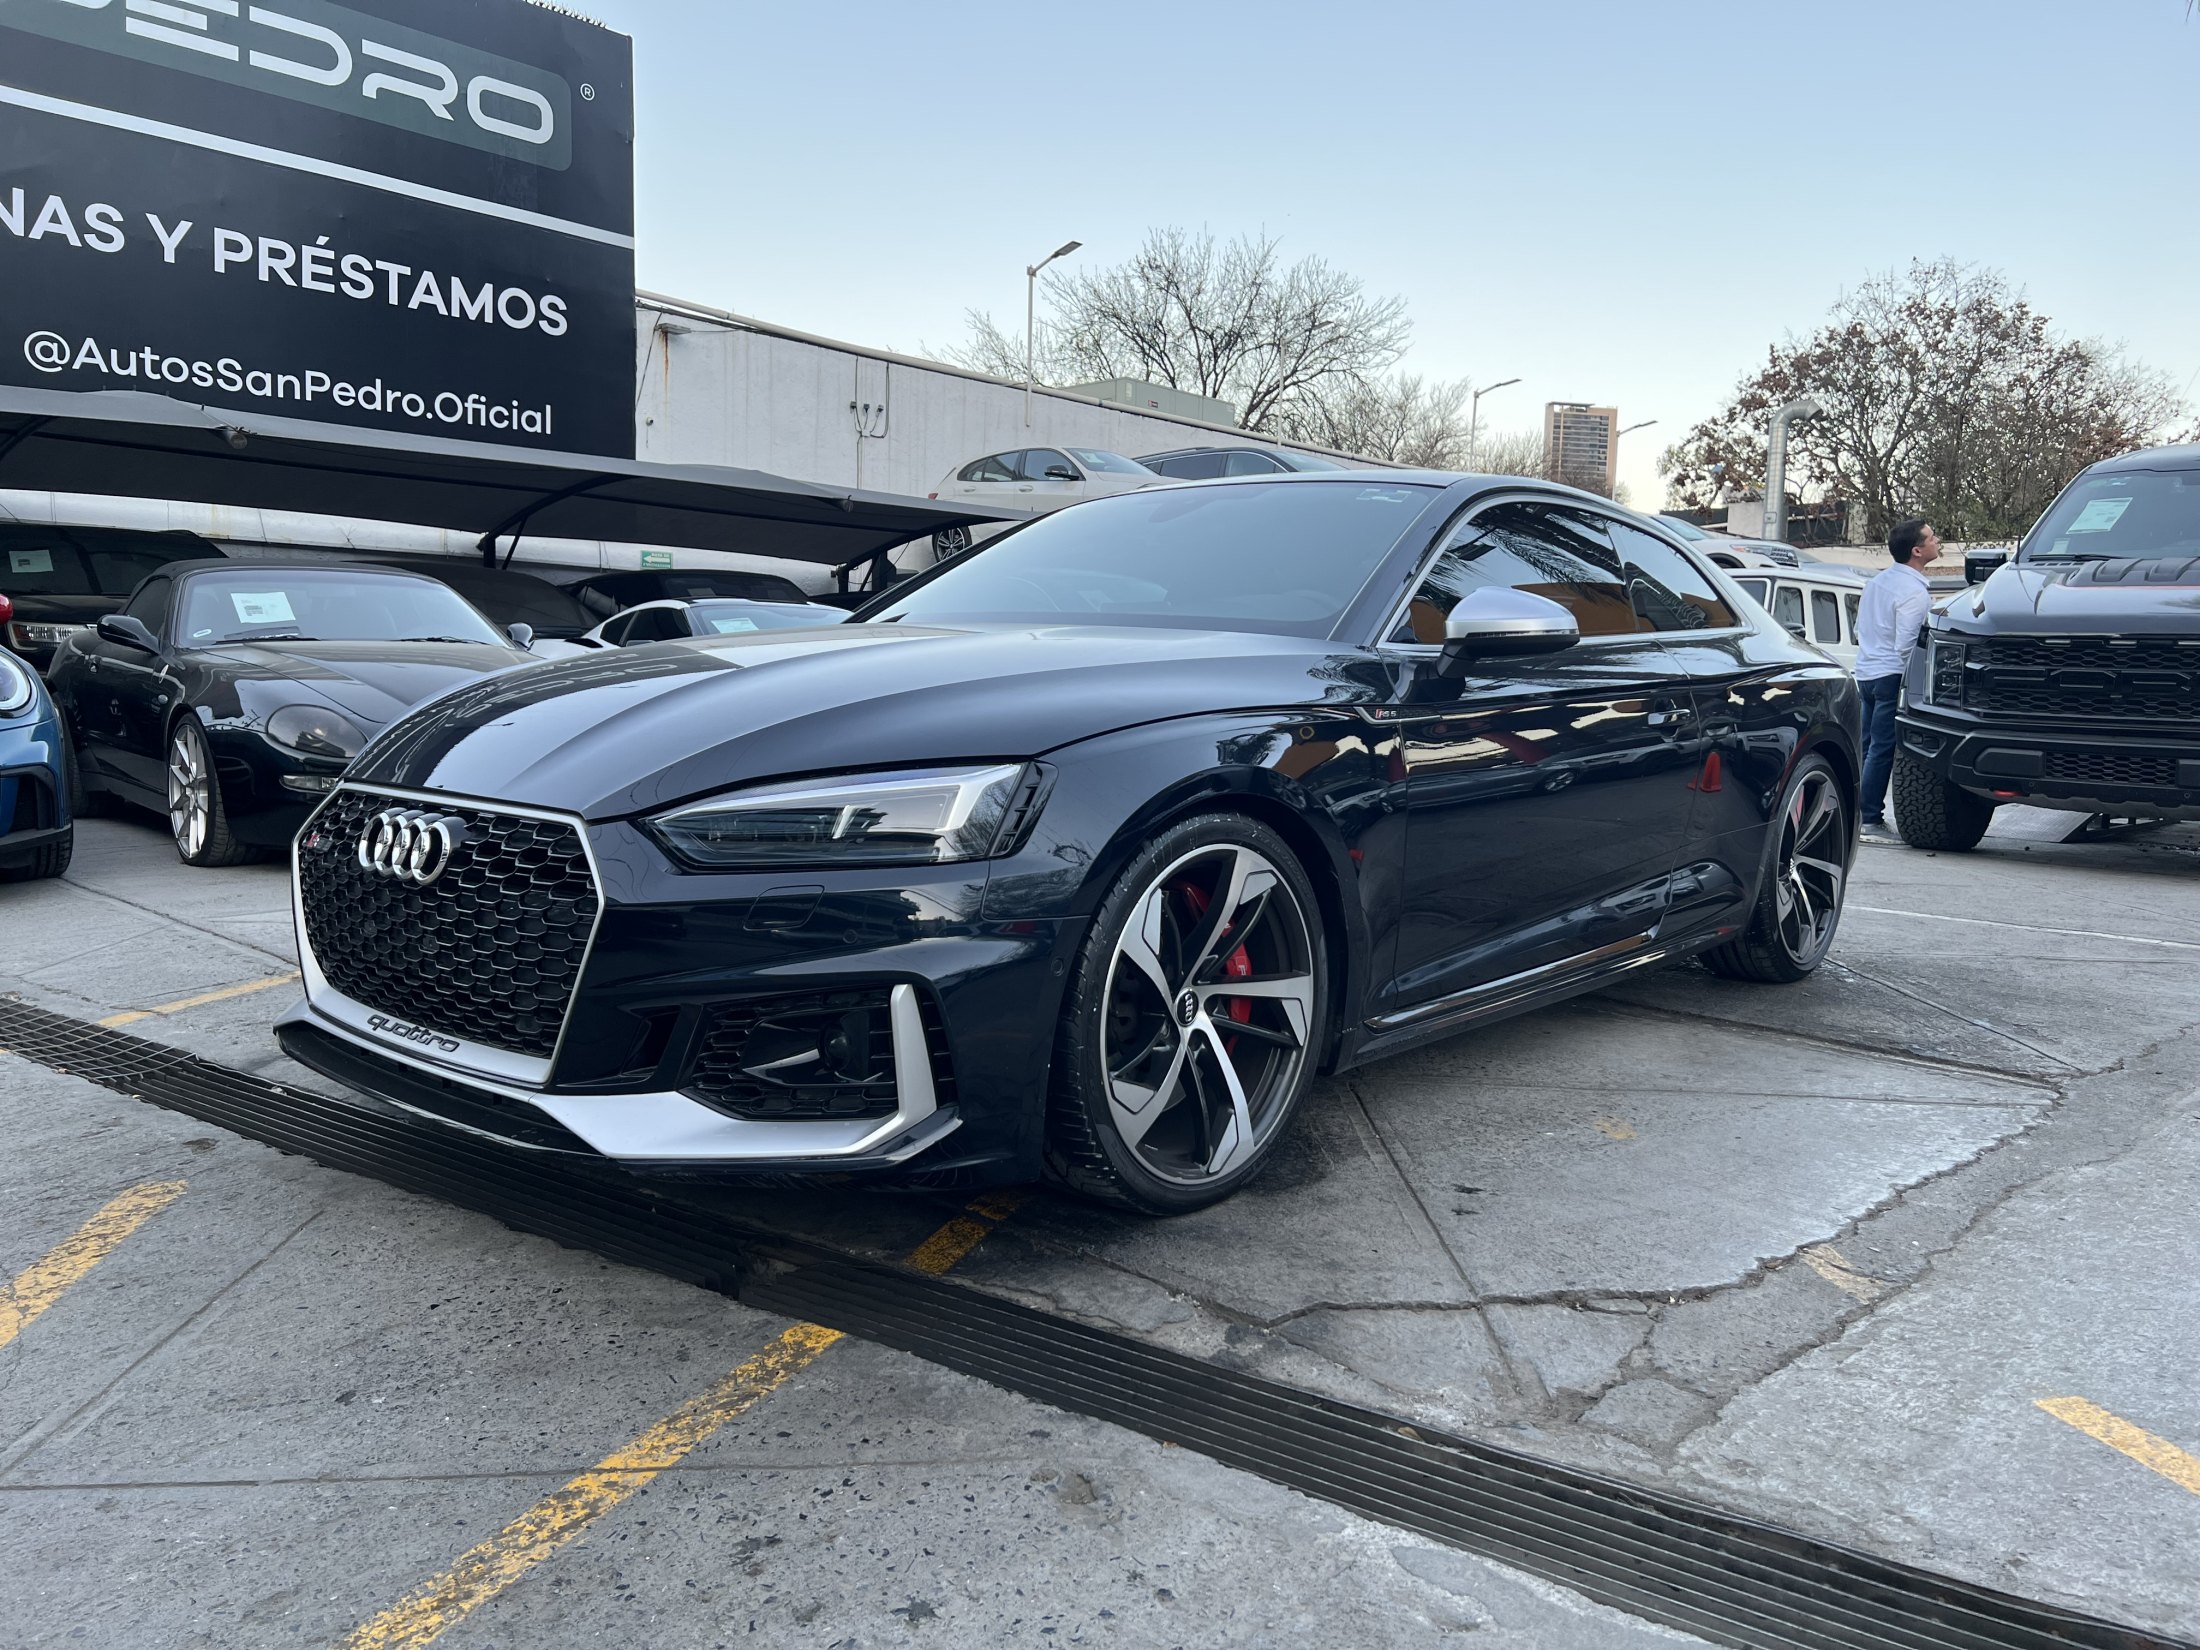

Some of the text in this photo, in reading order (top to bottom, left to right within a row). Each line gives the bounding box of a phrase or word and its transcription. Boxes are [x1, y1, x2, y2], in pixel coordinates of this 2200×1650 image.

[60, 0, 554, 145] EDRO
[145, 212, 194, 264] Y
[213, 226, 568, 336] PRÉSTAMOS
[24, 330, 552, 435] @AutosSanPedro.Oficial
[366, 1013, 460, 1053] quattro
